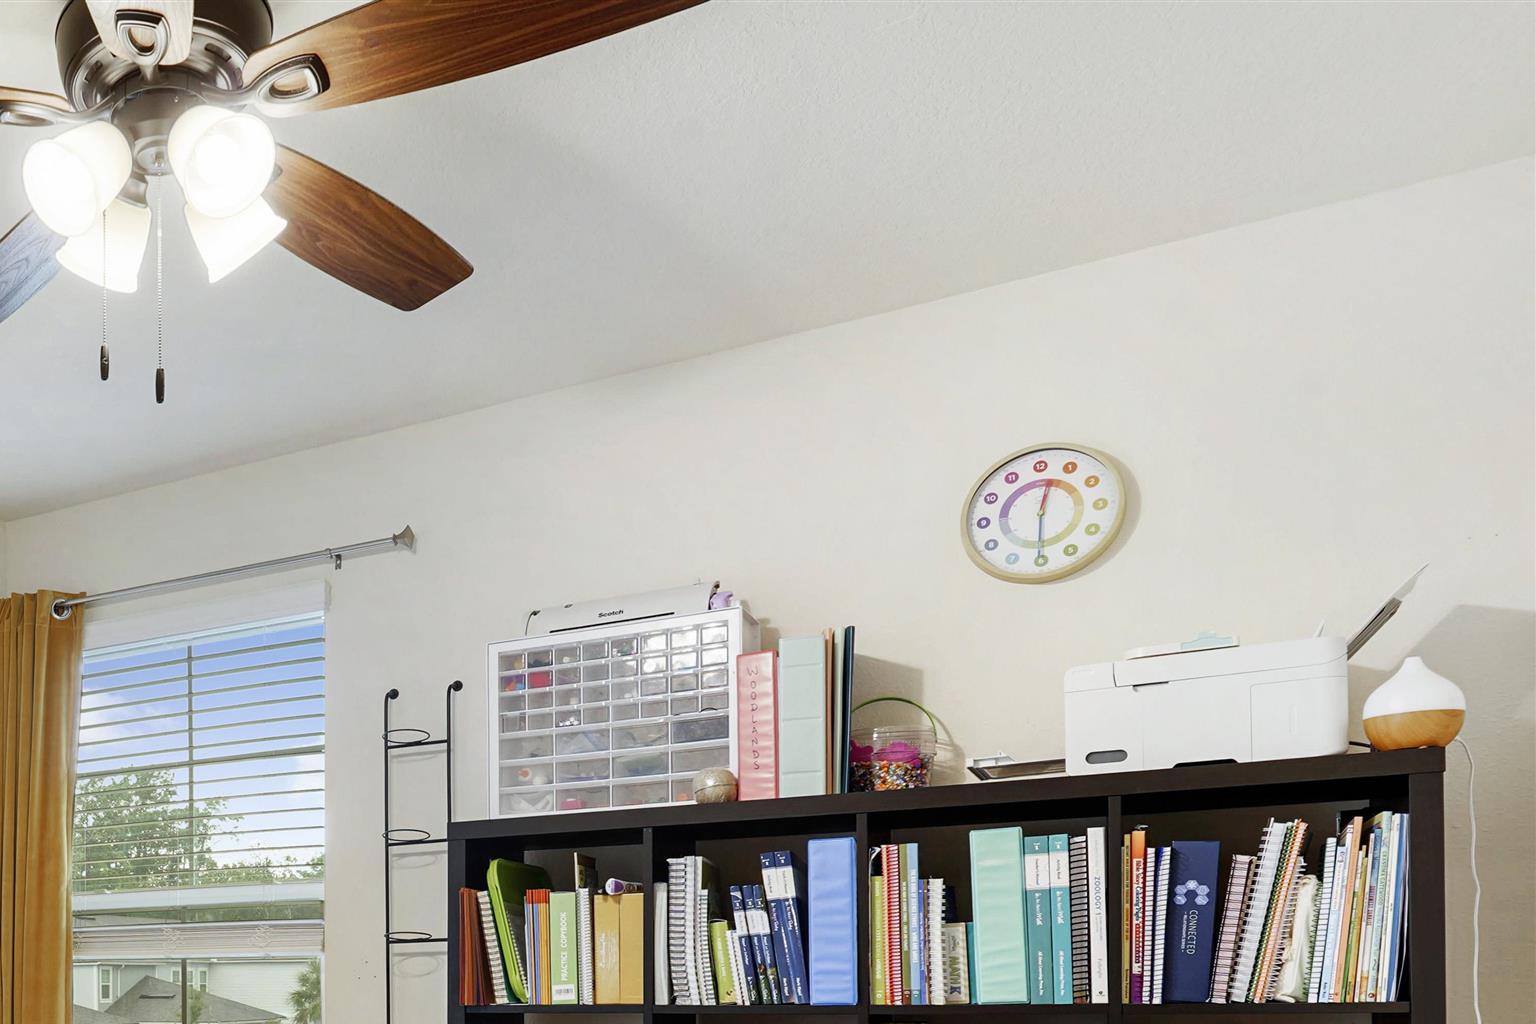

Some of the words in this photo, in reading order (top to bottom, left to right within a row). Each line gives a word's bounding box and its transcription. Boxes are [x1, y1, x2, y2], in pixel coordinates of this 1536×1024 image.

[1035, 462, 1046, 470] 12
[597, 609, 624, 618] Scotch
[746, 665, 760, 770] WOODLANDS
[1094, 876, 1102, 910] ZOOLOGY
[1133, 886, 1142, 907] Coloring
[560, 912, 568, 948] COPYBOOK
[1186, 910, 1199, 955] CONNECTED
[560, 952, 569, 982] PRACTICE
[948, 956, 960, 985] MATH
[950, 985, 961, 996] K
